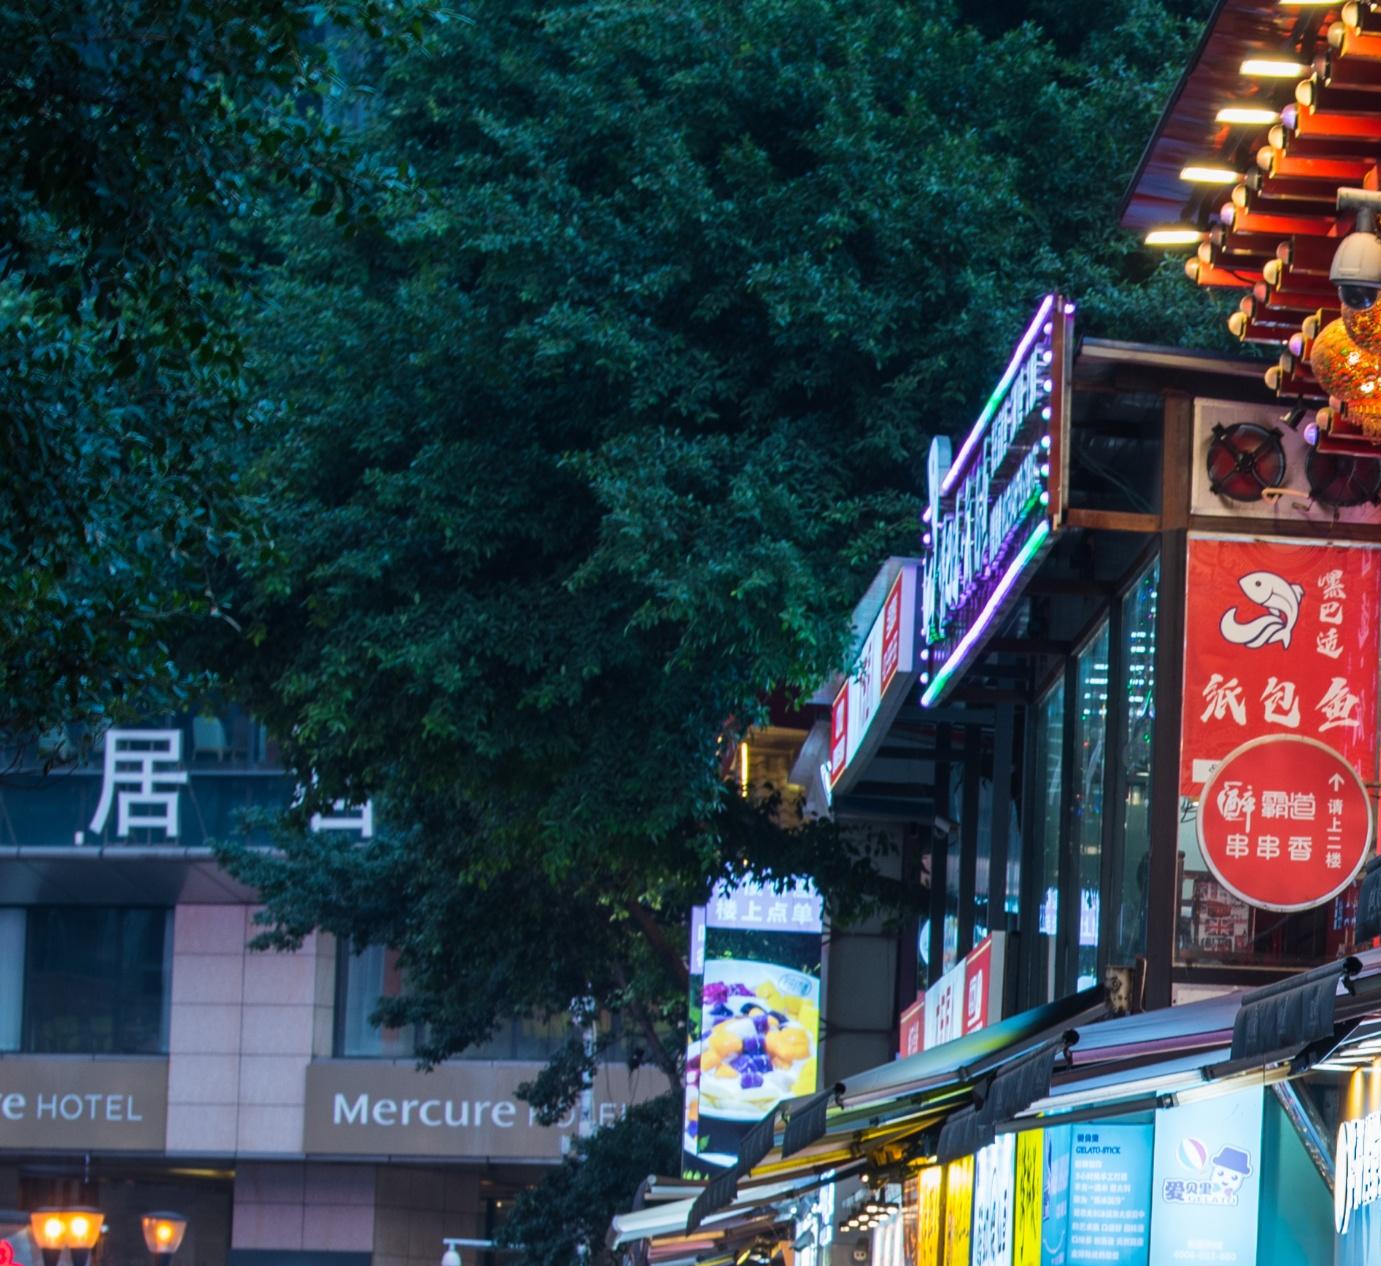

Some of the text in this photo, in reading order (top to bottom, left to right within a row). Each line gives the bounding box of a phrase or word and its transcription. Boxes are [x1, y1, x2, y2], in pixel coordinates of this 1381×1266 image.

[1316, 569, 1347, 659] 嘿巴适
[1201, 673, 1361, 732] 纸包鱼
[90, 729, 188, 836] 居
[1217, 781, 1316, 833] 醉霸道
[1226, 834, 1312, 861] 串串香
[1325, 798, 1344, 869] 请上二楼
[716, 900, 813, 924] 楼上点单
[37, 1094, 143, 1121] HOTEL
[333, 1092, 516, 1127] Mercure
